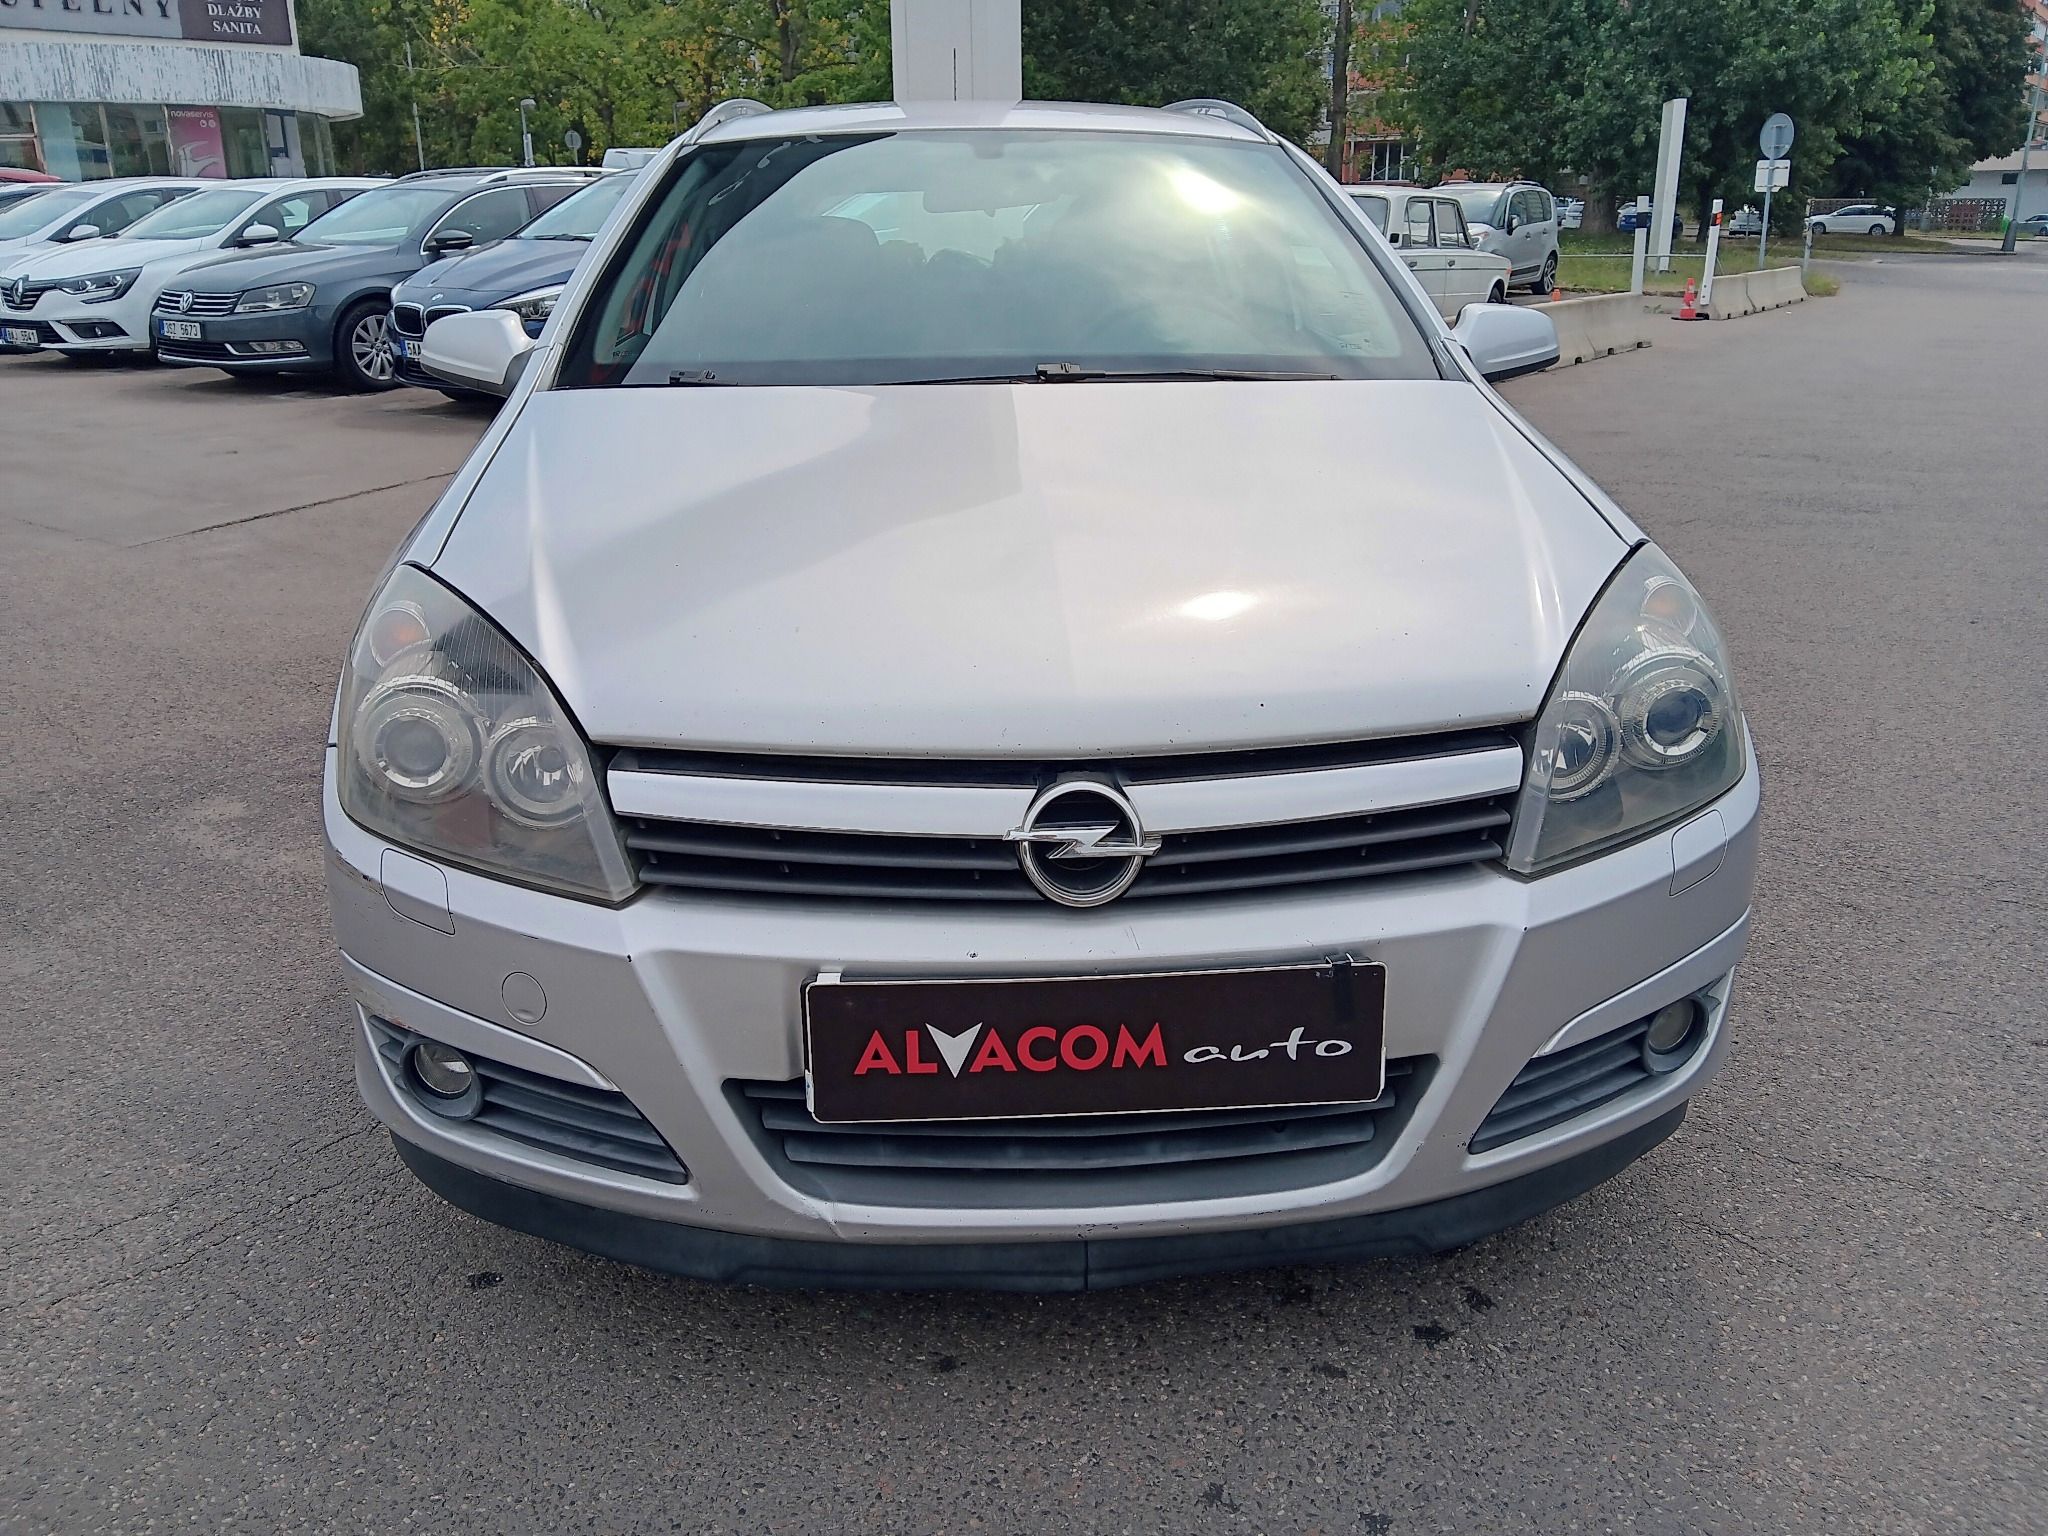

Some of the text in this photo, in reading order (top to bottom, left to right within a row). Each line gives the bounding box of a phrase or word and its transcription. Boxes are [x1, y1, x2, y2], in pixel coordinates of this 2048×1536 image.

[0, 0, 169, 17] ELNY
[207, 2, 262, 19] DLAŽBY
[212, 20, 263, 35] SANITA
[170, 110, 214, 118] novaservis
[180, 323, 198, 337] 5673
[853, 1022, 1353, 1078] ALVACOM auto
